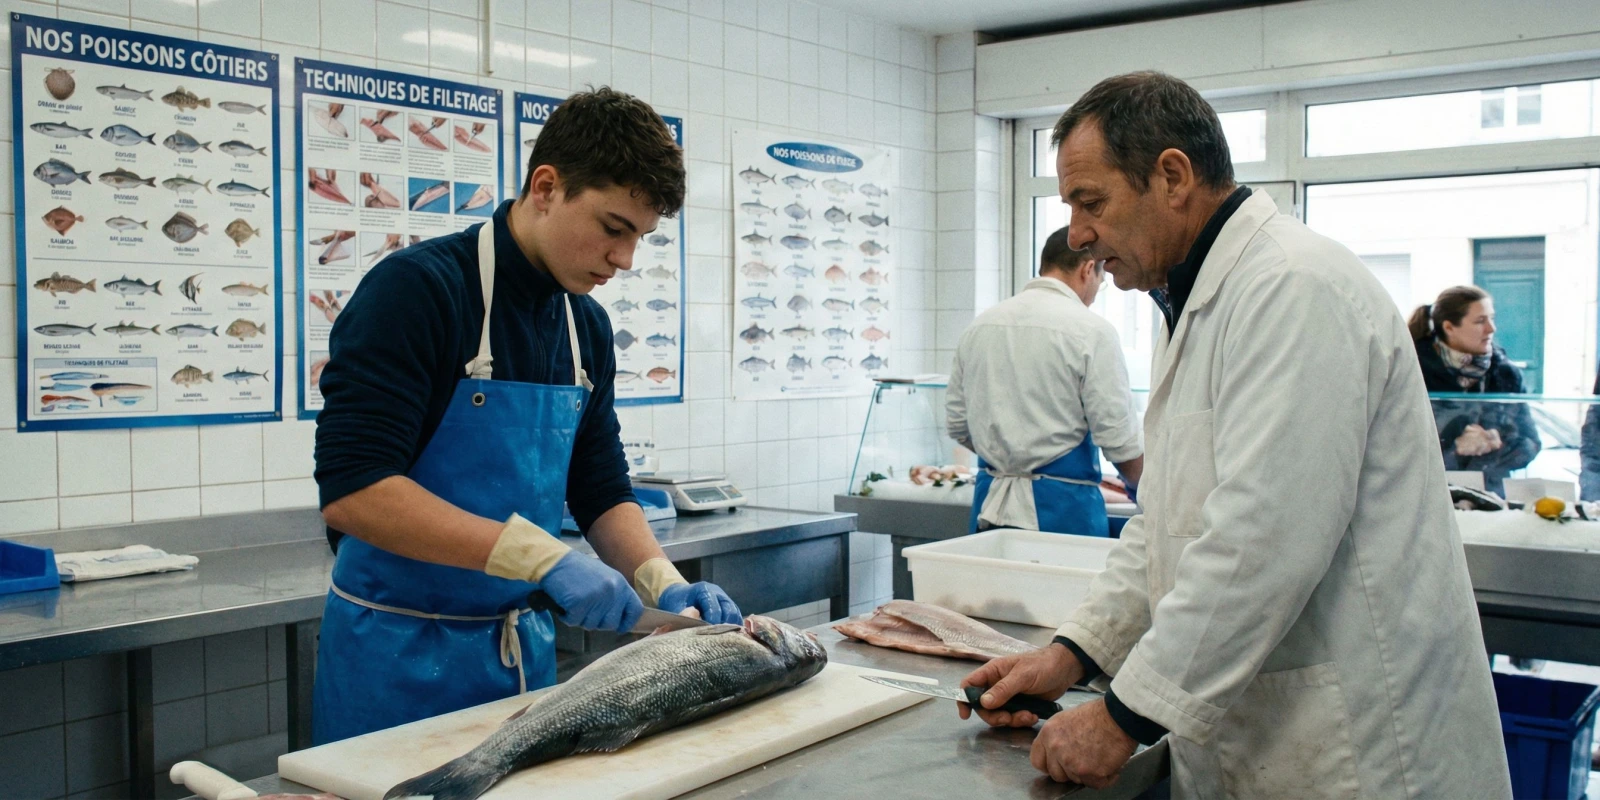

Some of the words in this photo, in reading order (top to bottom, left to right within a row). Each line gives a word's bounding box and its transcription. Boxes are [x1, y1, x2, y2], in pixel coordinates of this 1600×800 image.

[25, 25, 74, 54] NOS
[80, 34, 186, 69] POISSONS
[190, 48, 269, 82] CÔTIERS
[303, 67, 405, 101] TECHNIQUES
[409, 84, 430, 104] DE
[433, 87, 496, 114] FILETAGE
[522, 100, 551, 121] NOS
[773, 147, 789, 158] NOS
[790, 149, 826, 164] POISSONS
